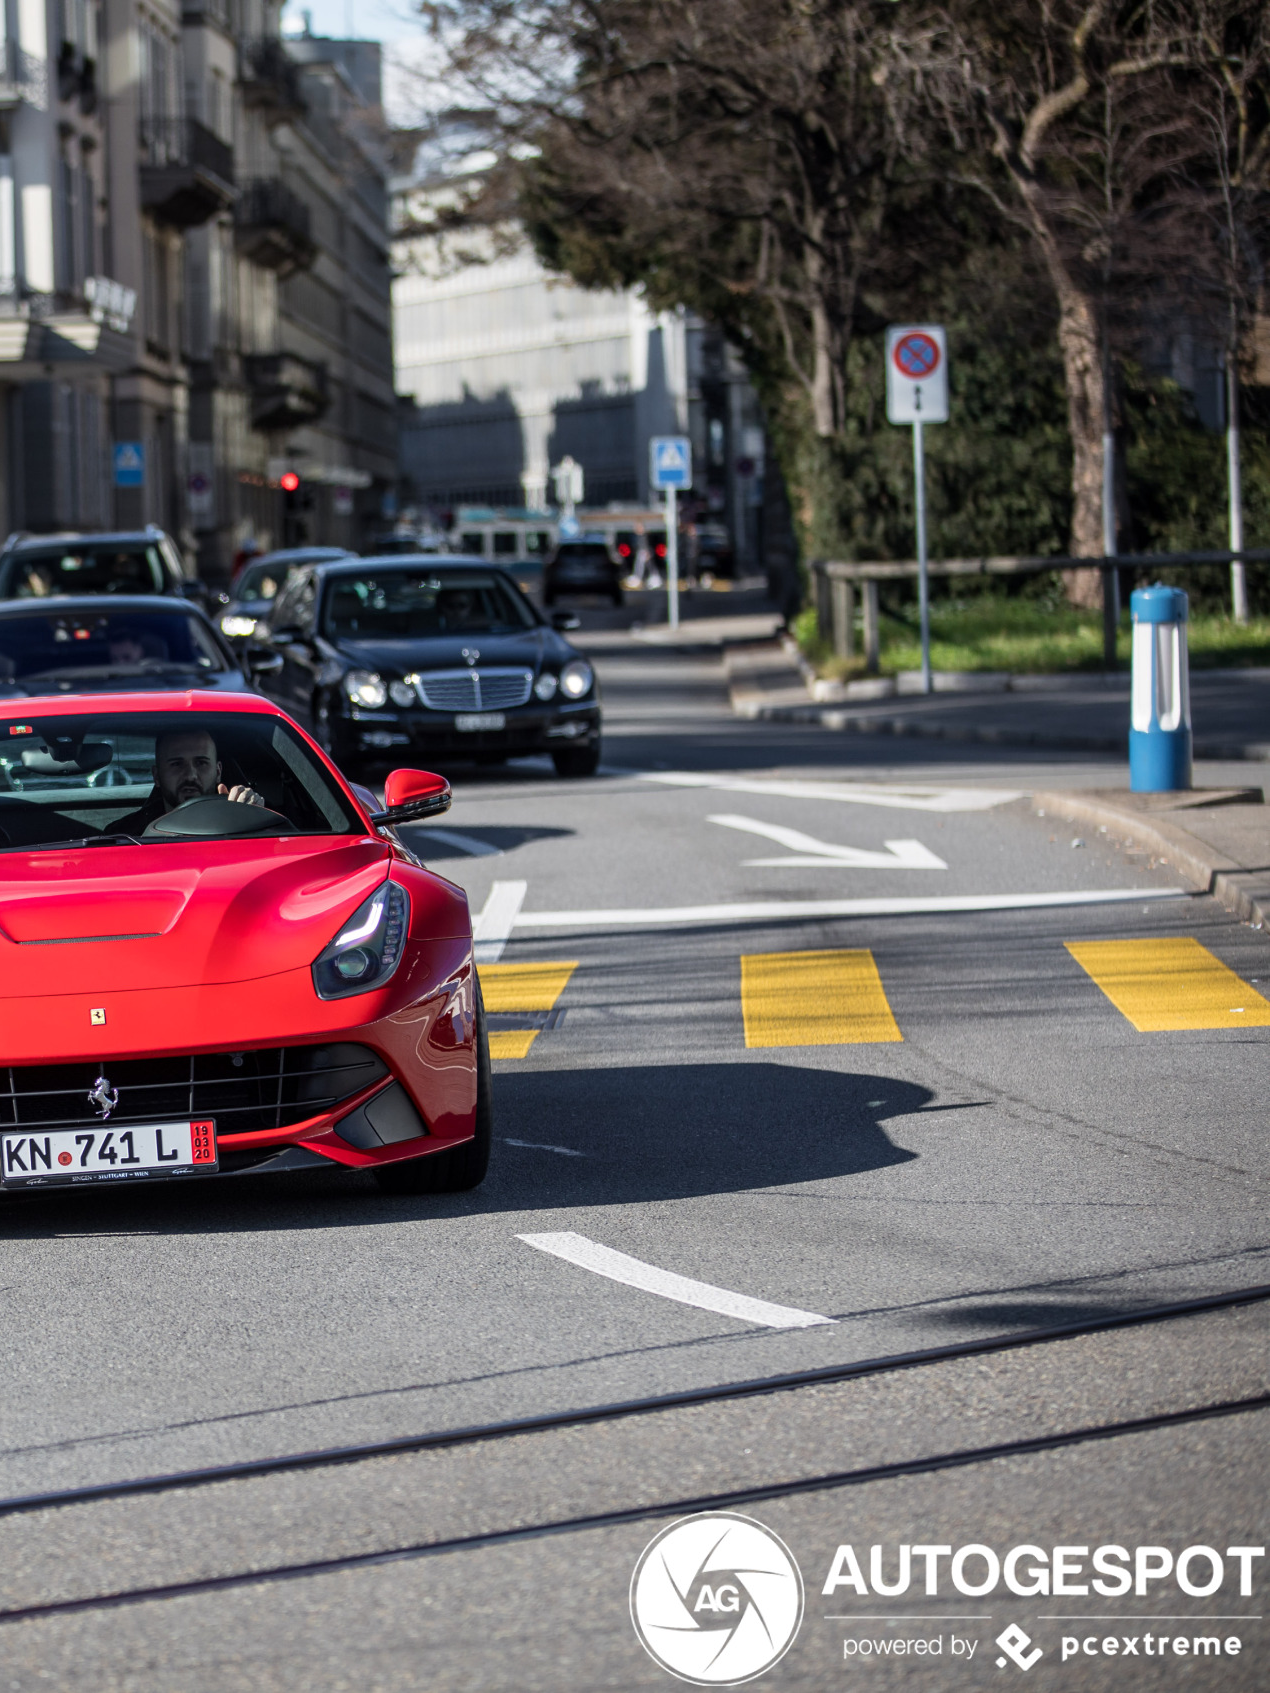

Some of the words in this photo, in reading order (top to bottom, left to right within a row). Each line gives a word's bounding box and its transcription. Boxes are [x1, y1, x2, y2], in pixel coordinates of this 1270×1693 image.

[194, 1126, 208, 1136] 19
[194, 1137, 209, 1147] 03
[5, 1137, 52, 1172] KN
[75, 1131, 140, 1167] 741
[155, 1129, 178, 1162] L
[194, 1148, 210, 1159] 20
[98, 1172, 128, 1180] STUTTGART
